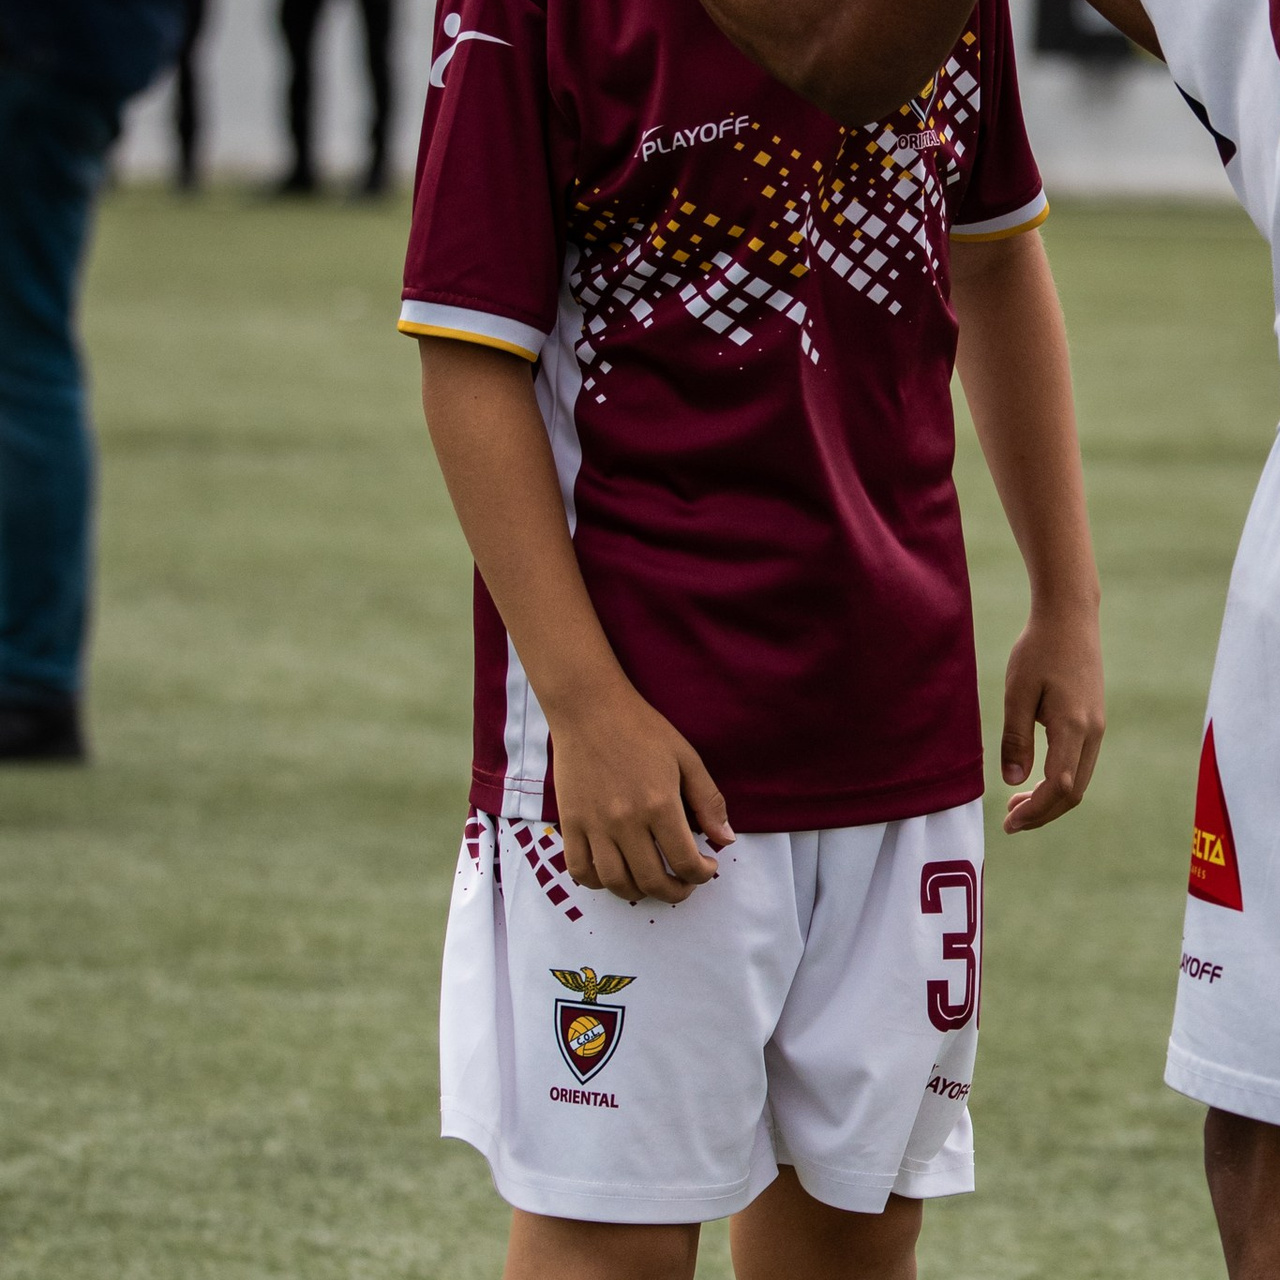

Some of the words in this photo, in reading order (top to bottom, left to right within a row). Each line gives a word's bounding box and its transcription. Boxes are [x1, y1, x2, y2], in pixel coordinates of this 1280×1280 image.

[642, 114, 749, 162] PLAYOFF
[920, 859, 985, 1032] 3
[1179, 951, 1223, 984] AYOFF
[576, 1029, 600, 1046] C.O.L.
[549, 1085, 619, 1109] ORIENTAL
[925, 1074, 970, 1101] AYOFF
